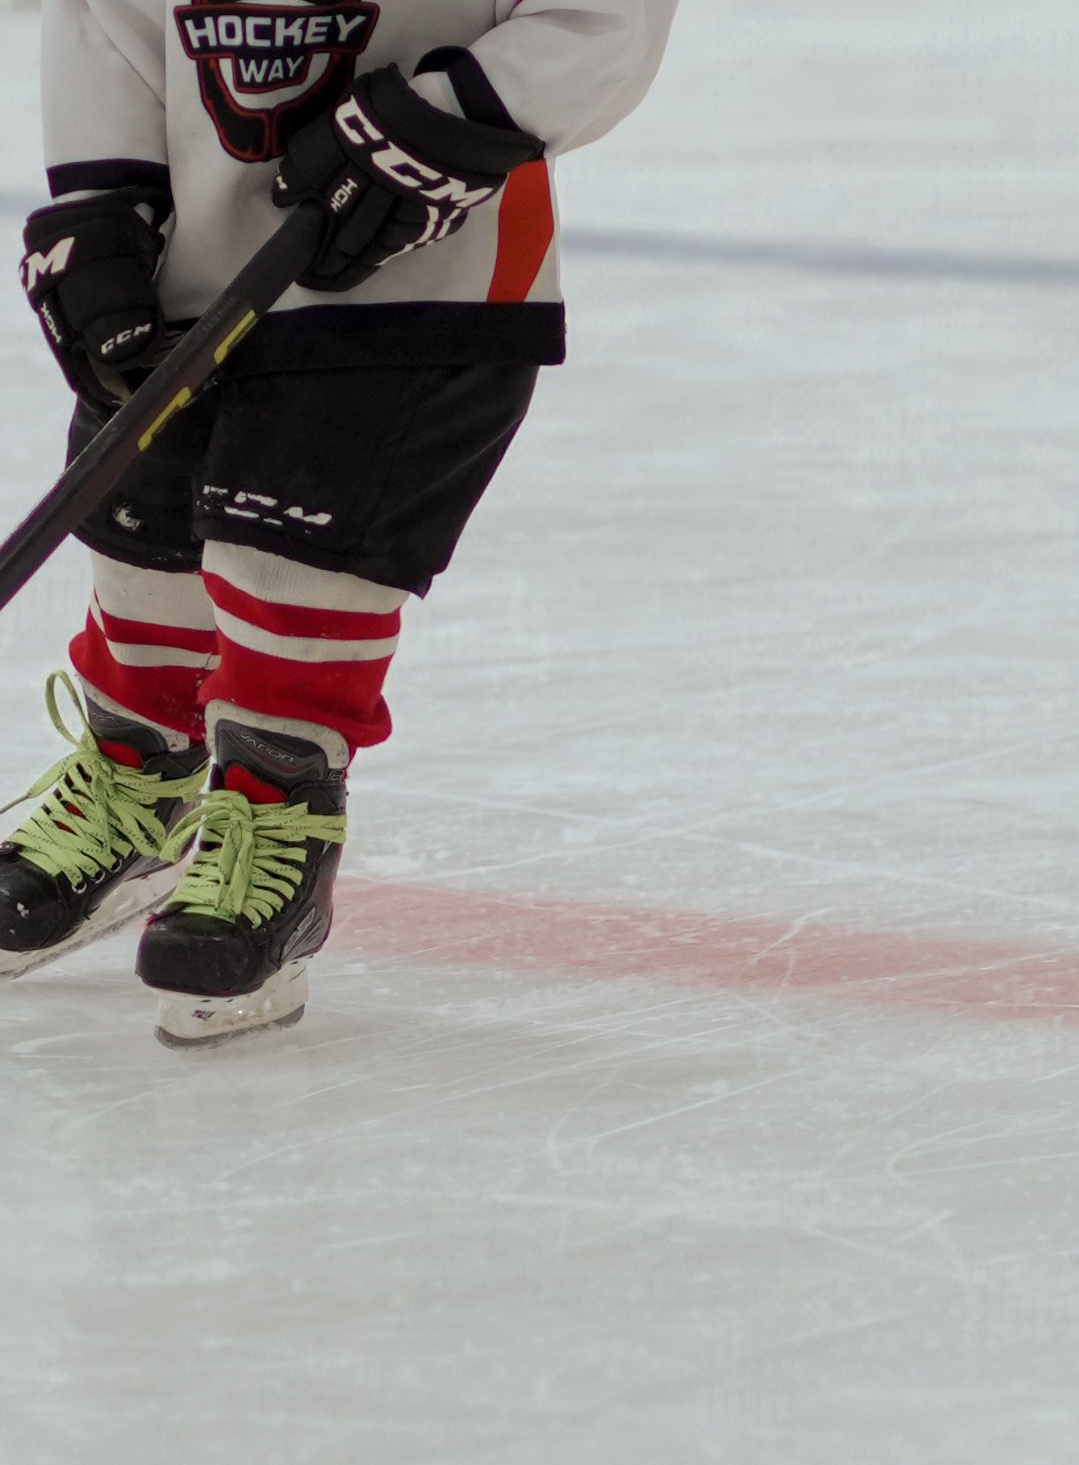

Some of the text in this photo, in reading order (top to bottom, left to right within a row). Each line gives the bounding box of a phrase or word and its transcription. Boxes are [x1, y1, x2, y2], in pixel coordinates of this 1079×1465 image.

[184, 14, 367, 49] HOCKEY
[238, 55, 306, 83] WAY
[334, 94, 494, 208] CCM
[101, 323, 152, 354] CCM
